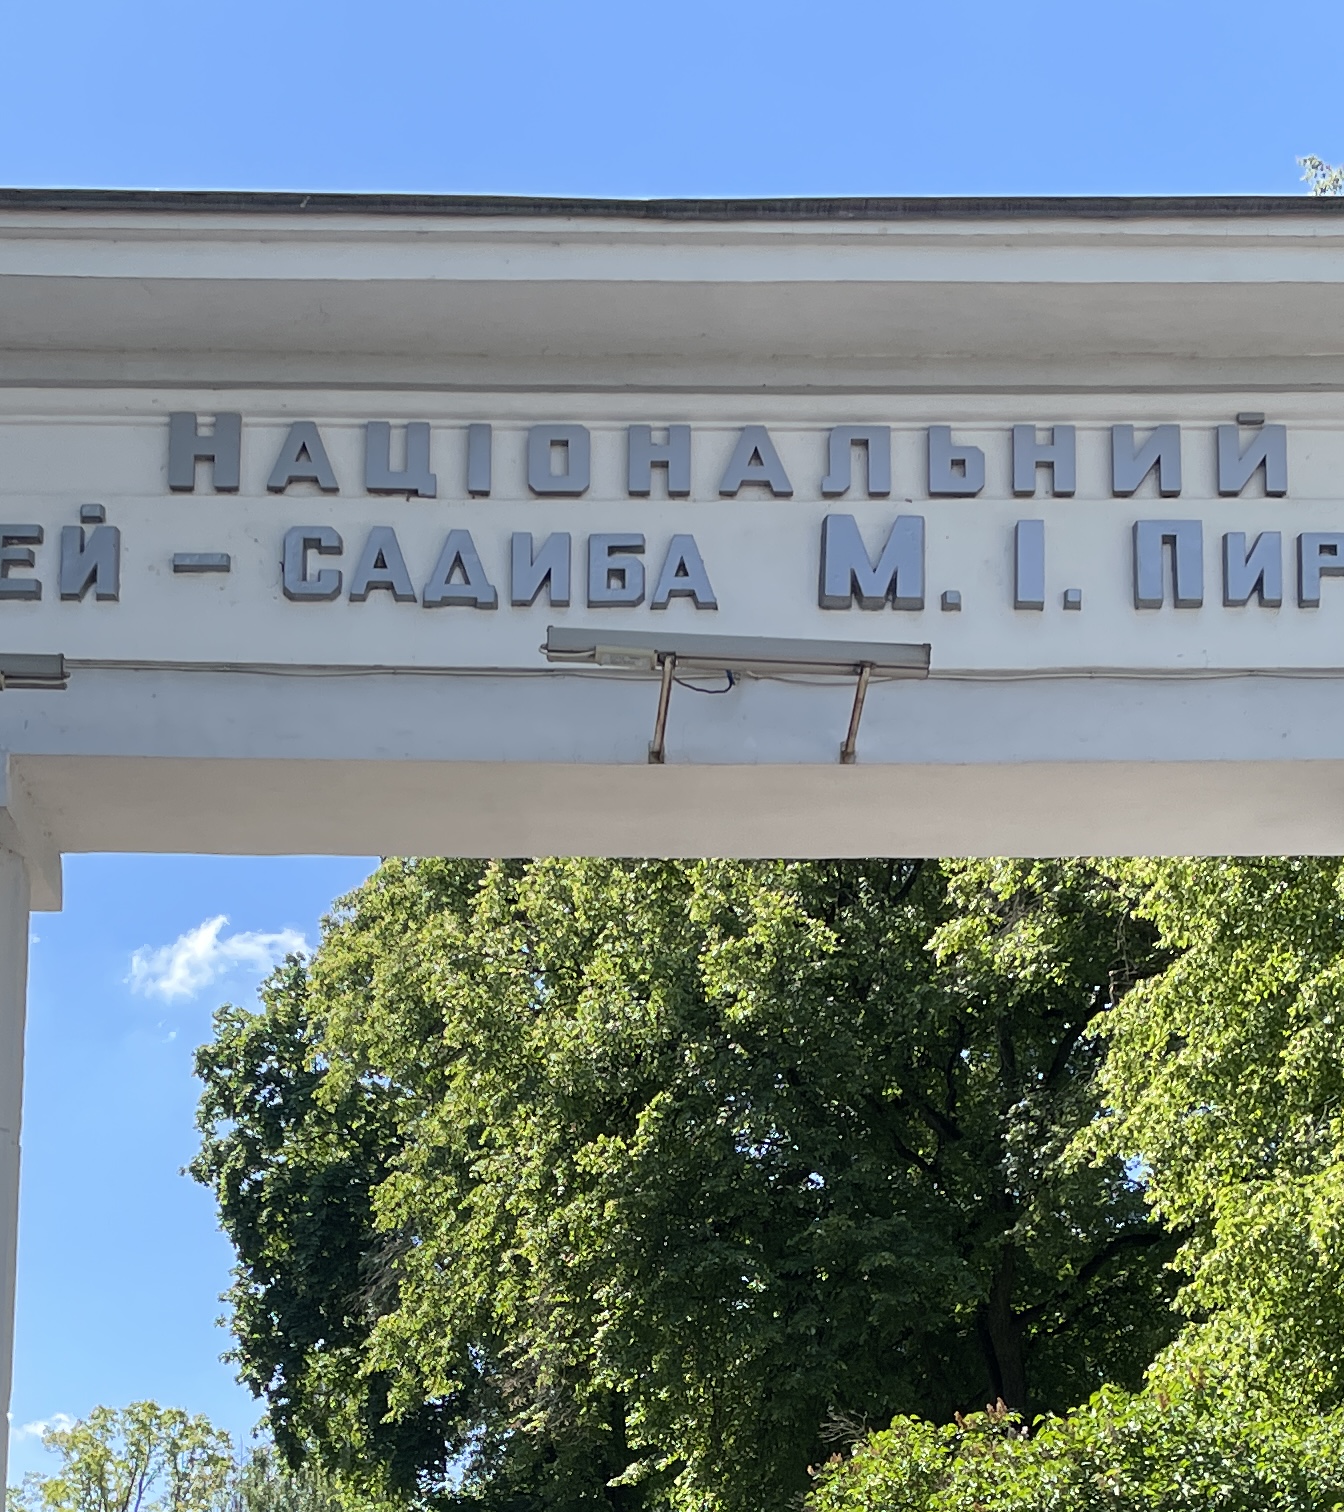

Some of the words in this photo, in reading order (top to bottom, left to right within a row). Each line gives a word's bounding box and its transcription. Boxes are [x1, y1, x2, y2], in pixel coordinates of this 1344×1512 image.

[167, 410, 1288, 499] НАЦІОНАЛЬНИЙ
[280, 524, 719, 611] САДИБА
[818, 514, 962, 611] М.
